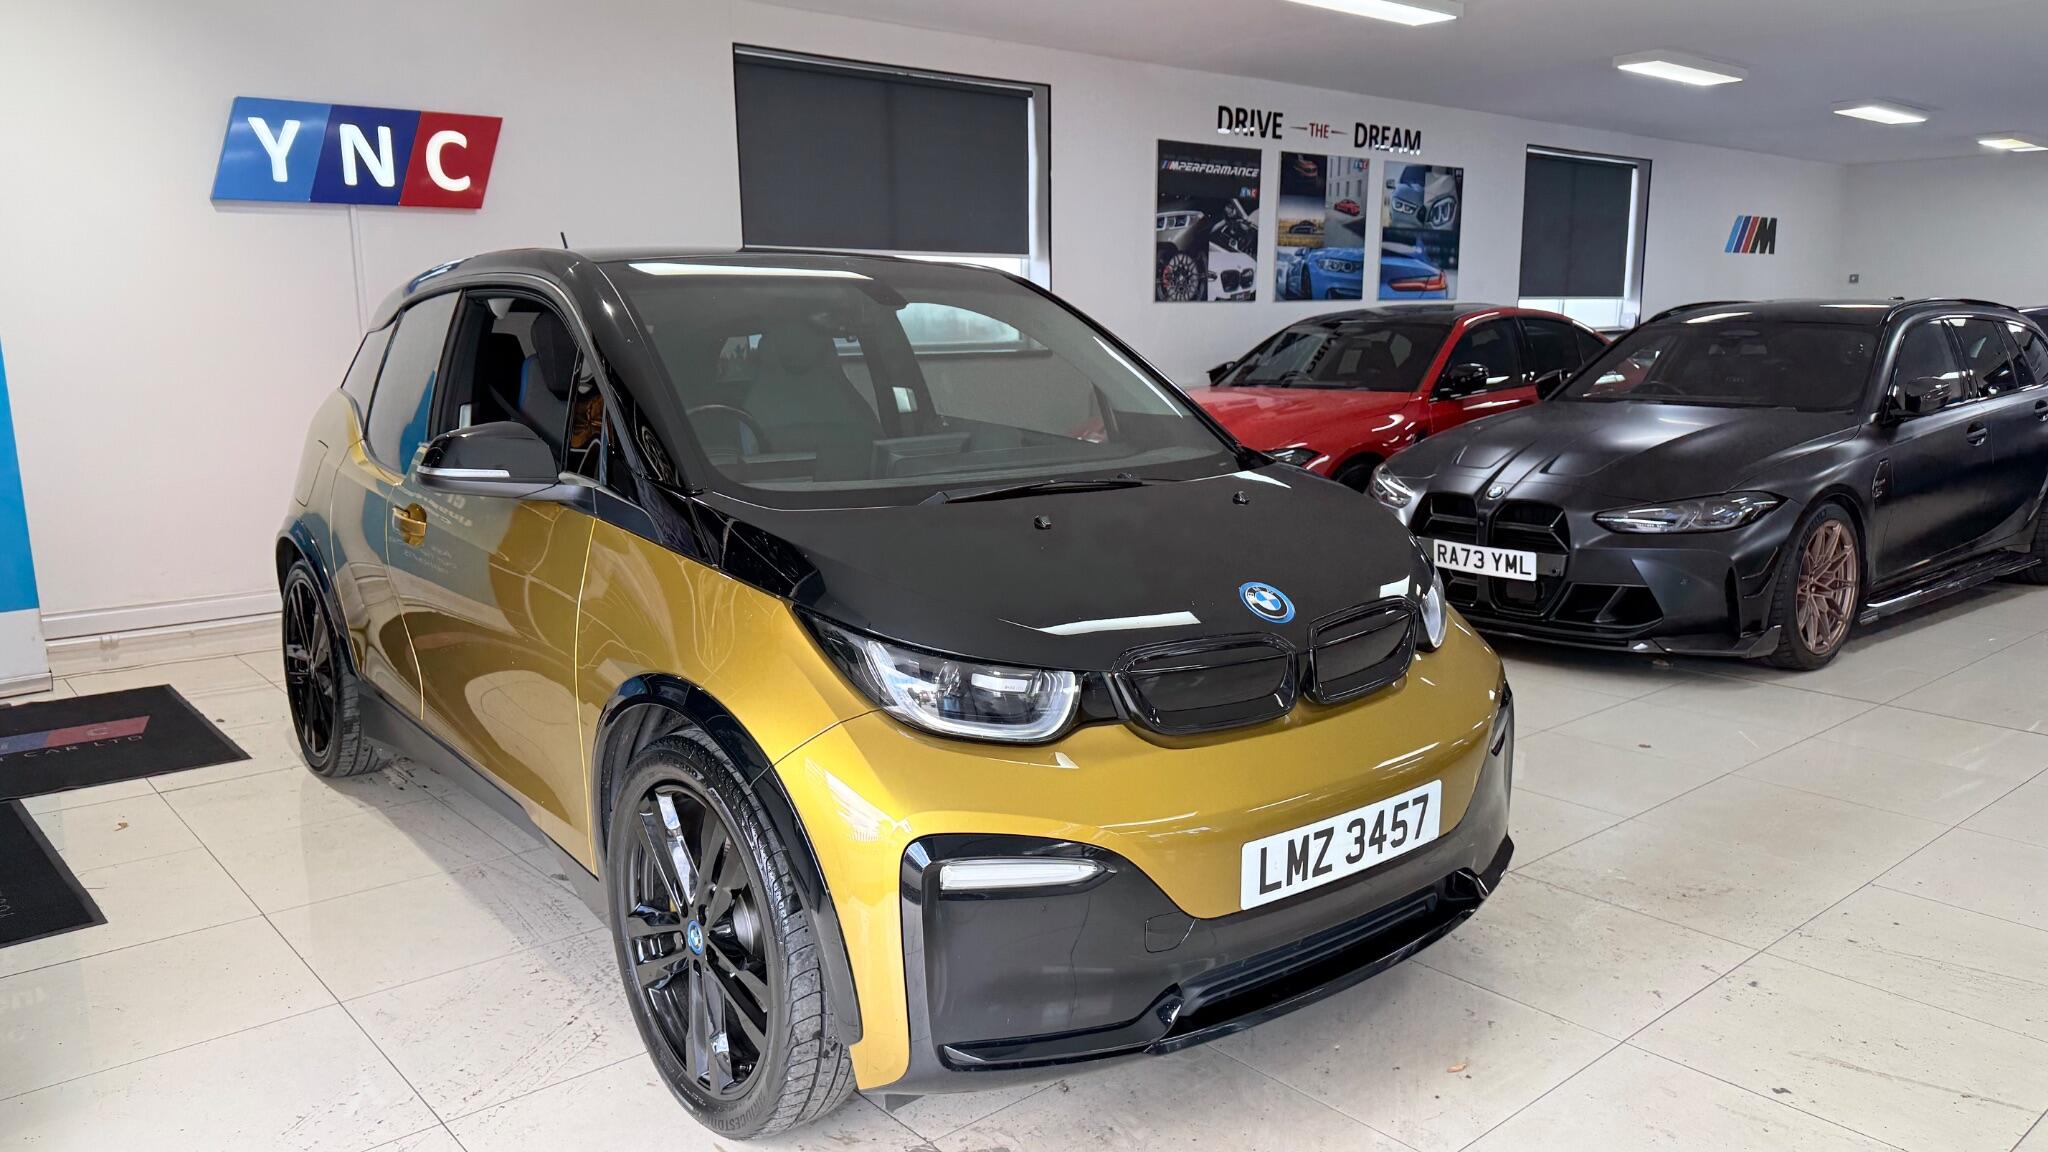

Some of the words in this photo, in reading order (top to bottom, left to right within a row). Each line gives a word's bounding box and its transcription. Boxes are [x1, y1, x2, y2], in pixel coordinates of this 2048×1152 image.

[247, 116, 471, 192] YNC
[1217, 105, 1284, 140] DRIVE
[1309, 122, 1330, 139] THE
[1354, 121, 1422, 155] DREAM
[1437, 543, 1485, 569] RA73
[1491, 551, 1532, 576] YML
[1258, 826, 1336, 896] LMZ
[1344, 792, 1430, 865] 3457
